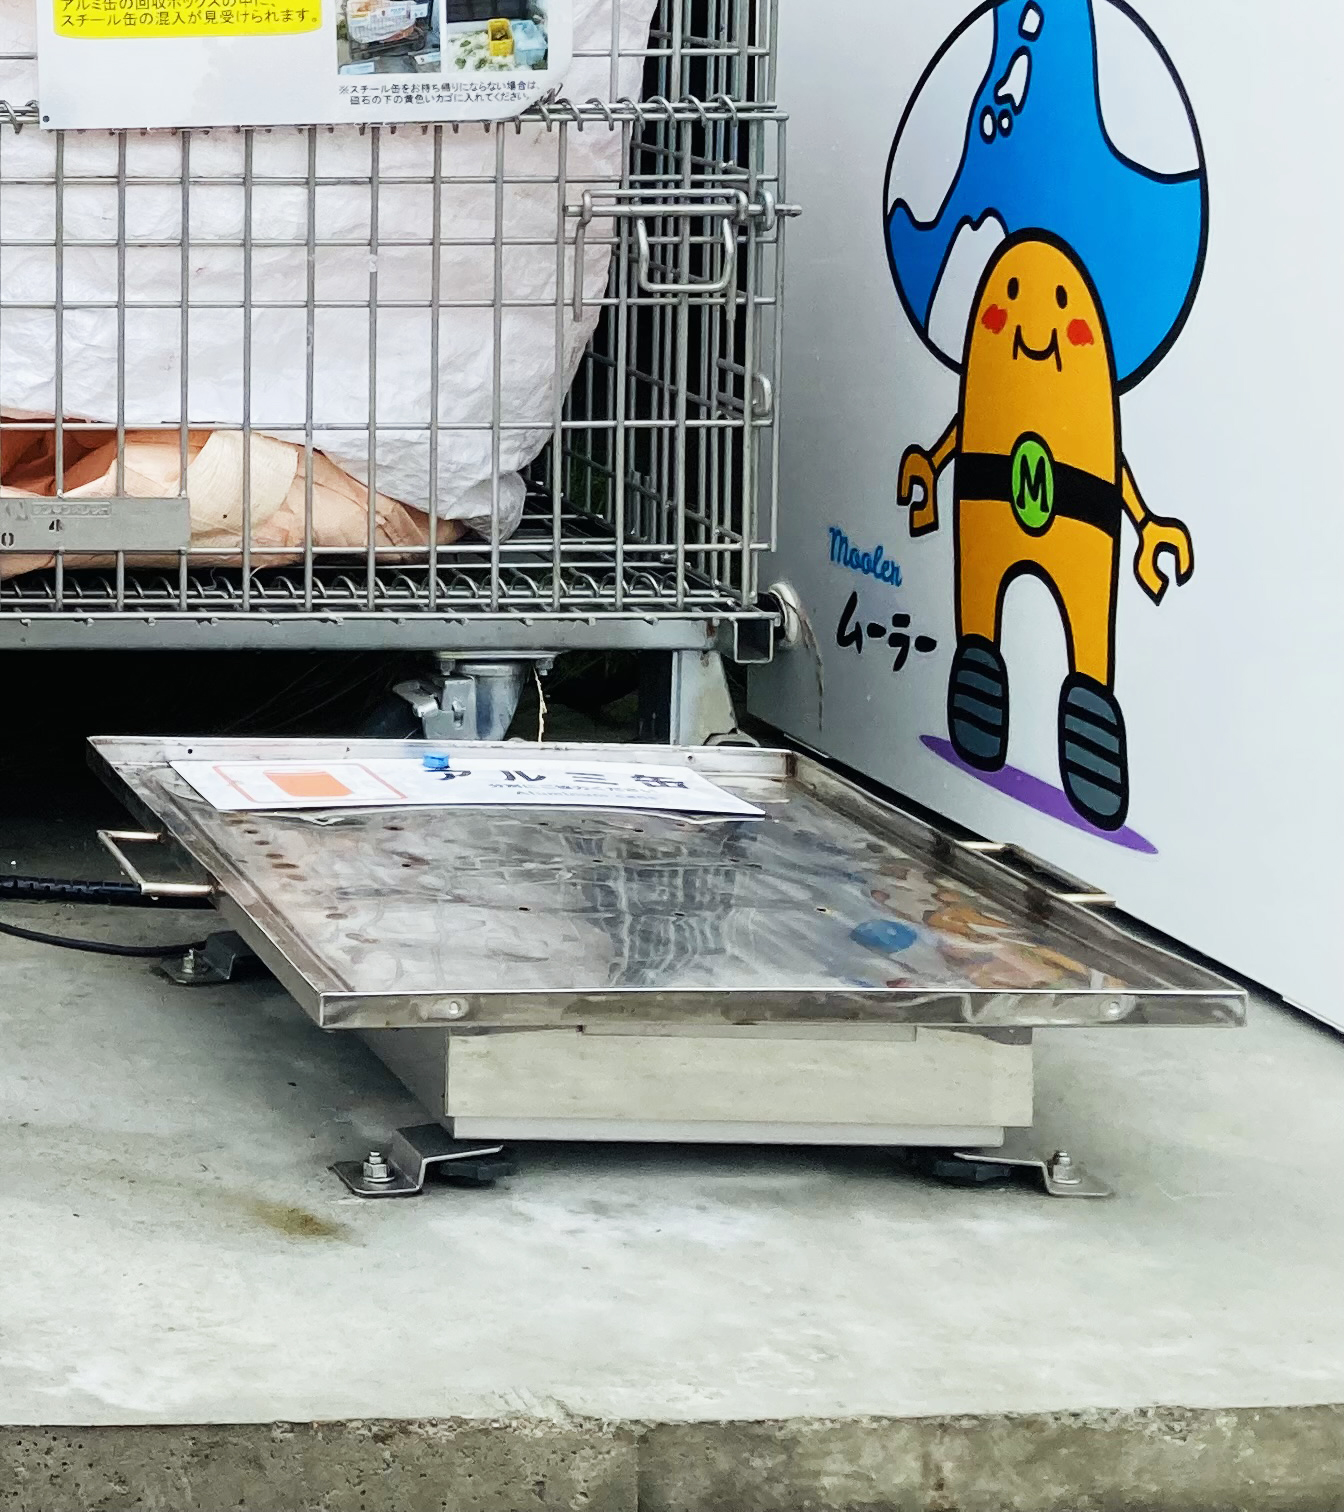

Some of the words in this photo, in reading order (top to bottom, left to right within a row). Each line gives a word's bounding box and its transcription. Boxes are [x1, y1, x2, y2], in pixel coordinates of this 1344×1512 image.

[62, 9, 317, 27] スチール缶の混入が見受けられます。
[1017, 454, 1049, 513] M
[836, 591, 937, 672] ムーラー
